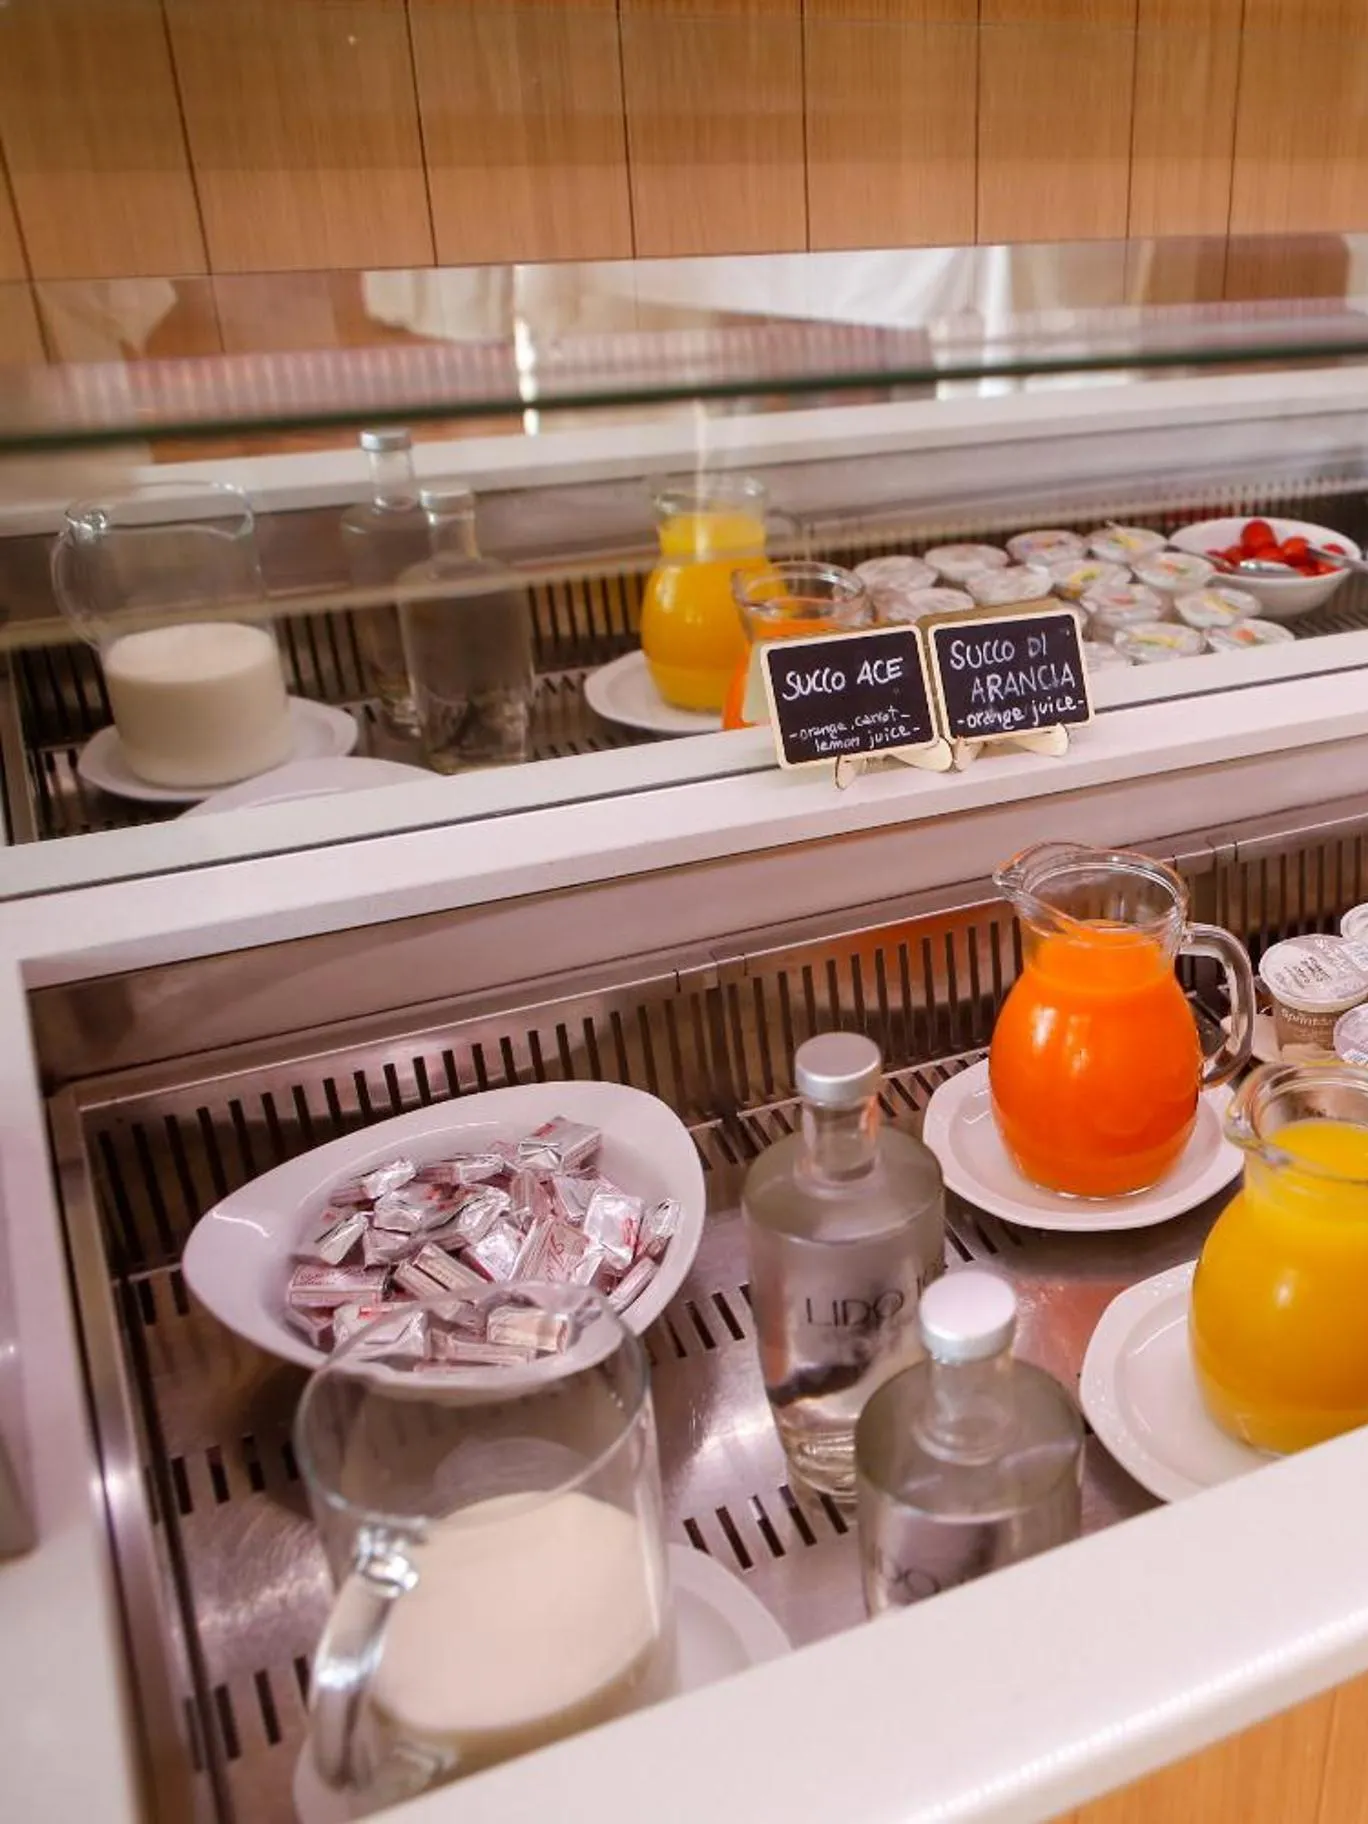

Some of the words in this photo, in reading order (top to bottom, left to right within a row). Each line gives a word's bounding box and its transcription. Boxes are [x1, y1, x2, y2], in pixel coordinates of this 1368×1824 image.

[950, 639, 1015, 671] SUCCO
[1028, 632, 1047, 657] DI
[782, 668, 846, 701] SUCCO
[856, 656, 904, 686] ACE
[971, 661, 1076, 703] ARANCIA
[815, 737, 860, 752] lemon
